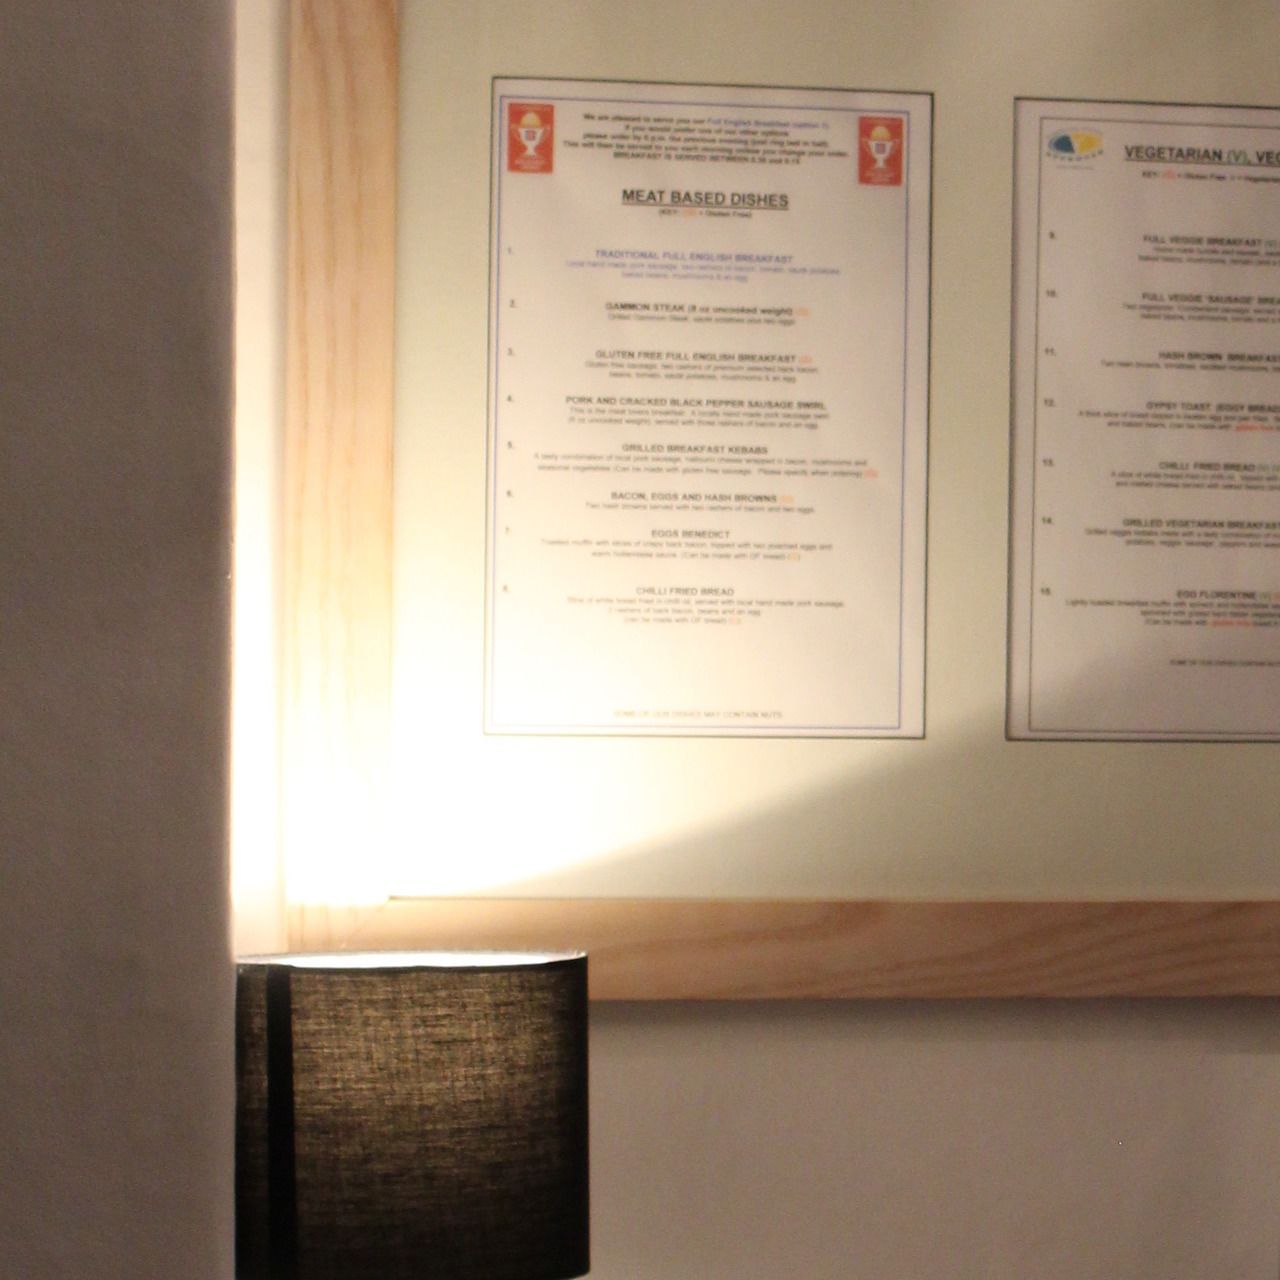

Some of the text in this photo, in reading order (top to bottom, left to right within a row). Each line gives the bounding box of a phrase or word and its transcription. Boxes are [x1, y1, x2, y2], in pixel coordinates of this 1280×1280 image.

[1125, 145, 1222, 161] VEGETARIAN
[622, 188, 789, 208] MEAT BASED DISHES
